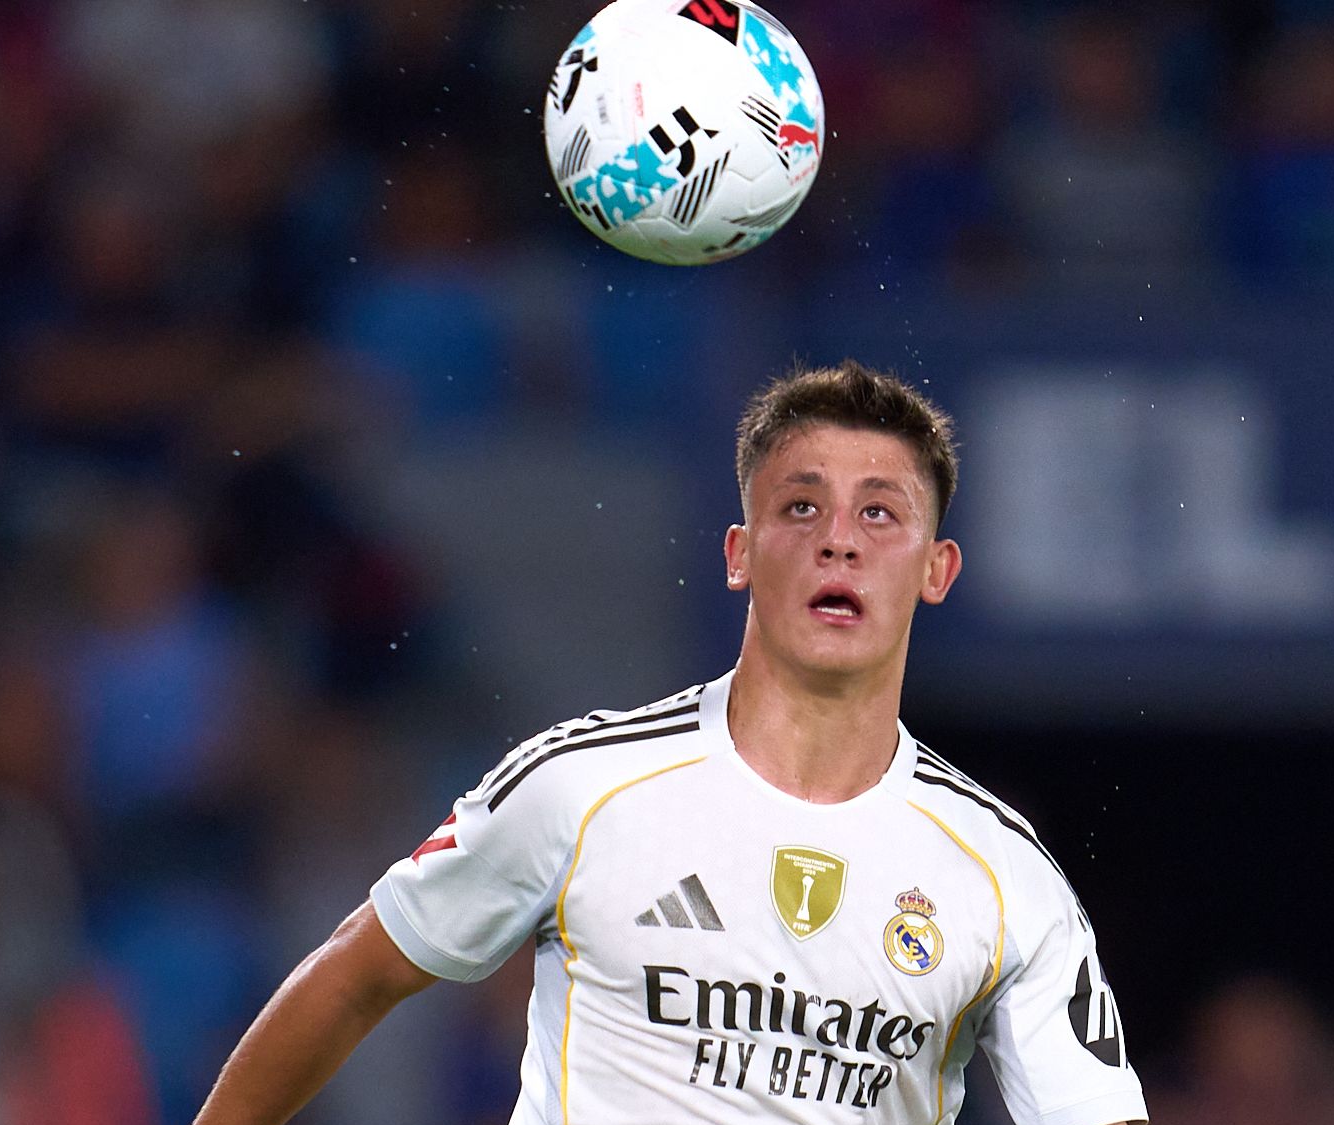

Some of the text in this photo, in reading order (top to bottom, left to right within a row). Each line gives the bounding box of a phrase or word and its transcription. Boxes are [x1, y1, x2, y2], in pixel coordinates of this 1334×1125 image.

[793, 922, 811, 932] FIFA
[643, 965, 935, 1061] Emirates
[689, 1038, 893, 1109] FLY BETTER
